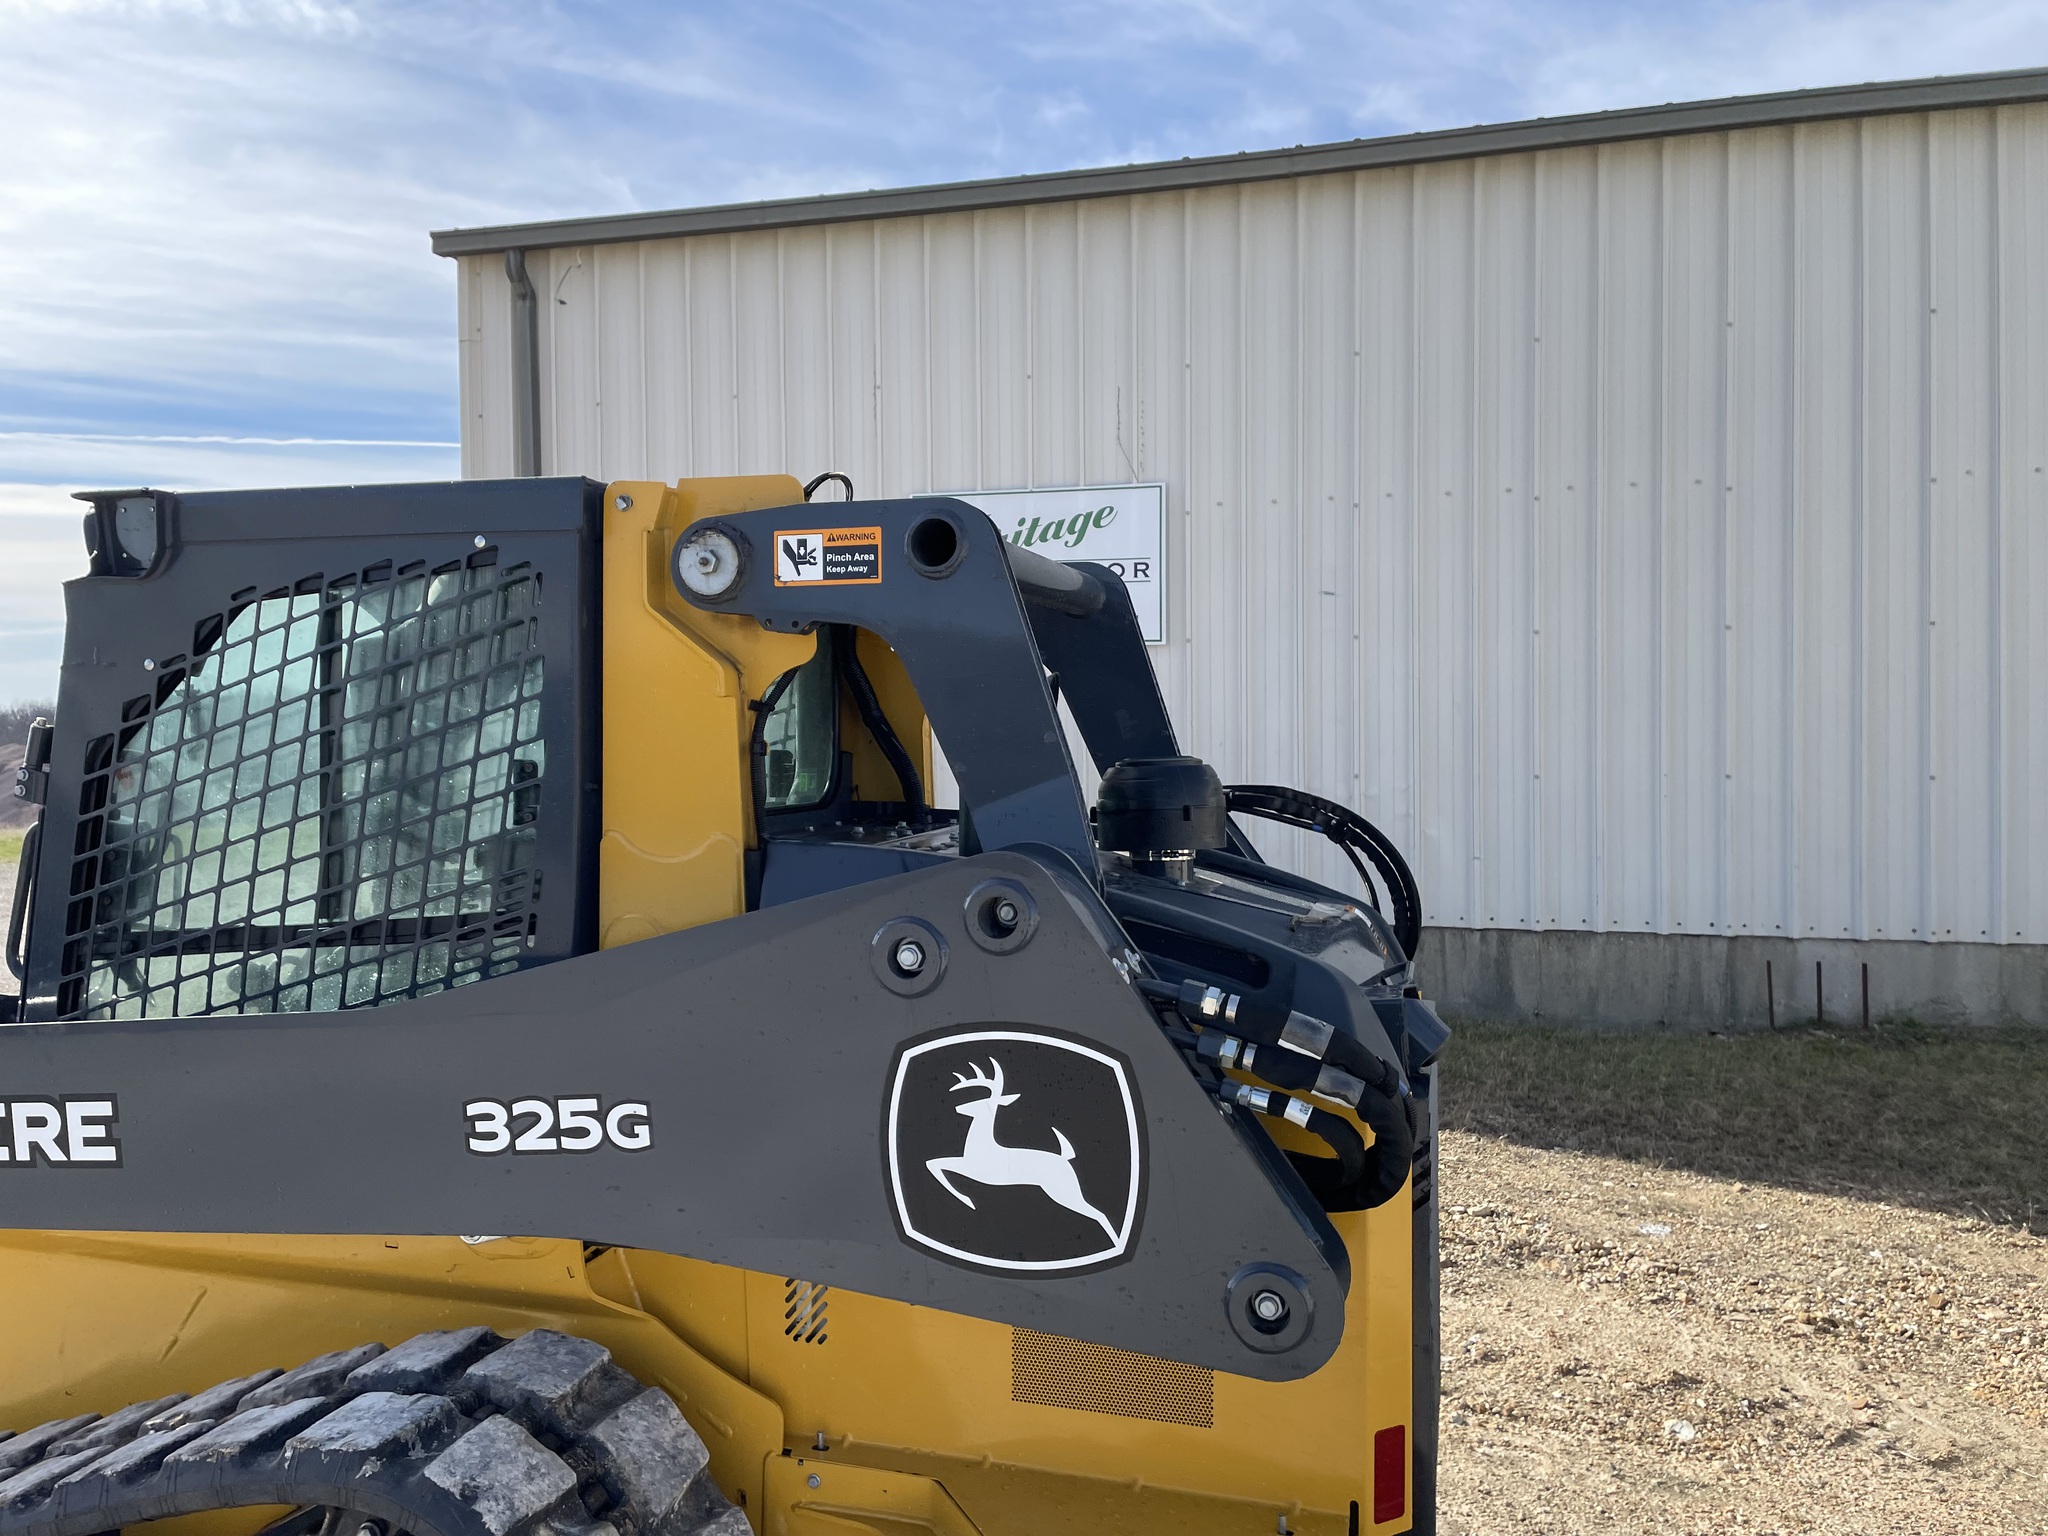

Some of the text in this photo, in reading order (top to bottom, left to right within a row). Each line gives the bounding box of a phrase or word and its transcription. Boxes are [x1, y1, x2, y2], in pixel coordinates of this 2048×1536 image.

[835, 532, 876, 541] WARNING
[1000, 505, 1118, 548] itage
[826, 552, 875, 562] Pinch Area
[826, 565, 868, 574] Keep Away
[0, 1101, 117, 1161] RE
[466, 1098, 651, 1153] 325G
